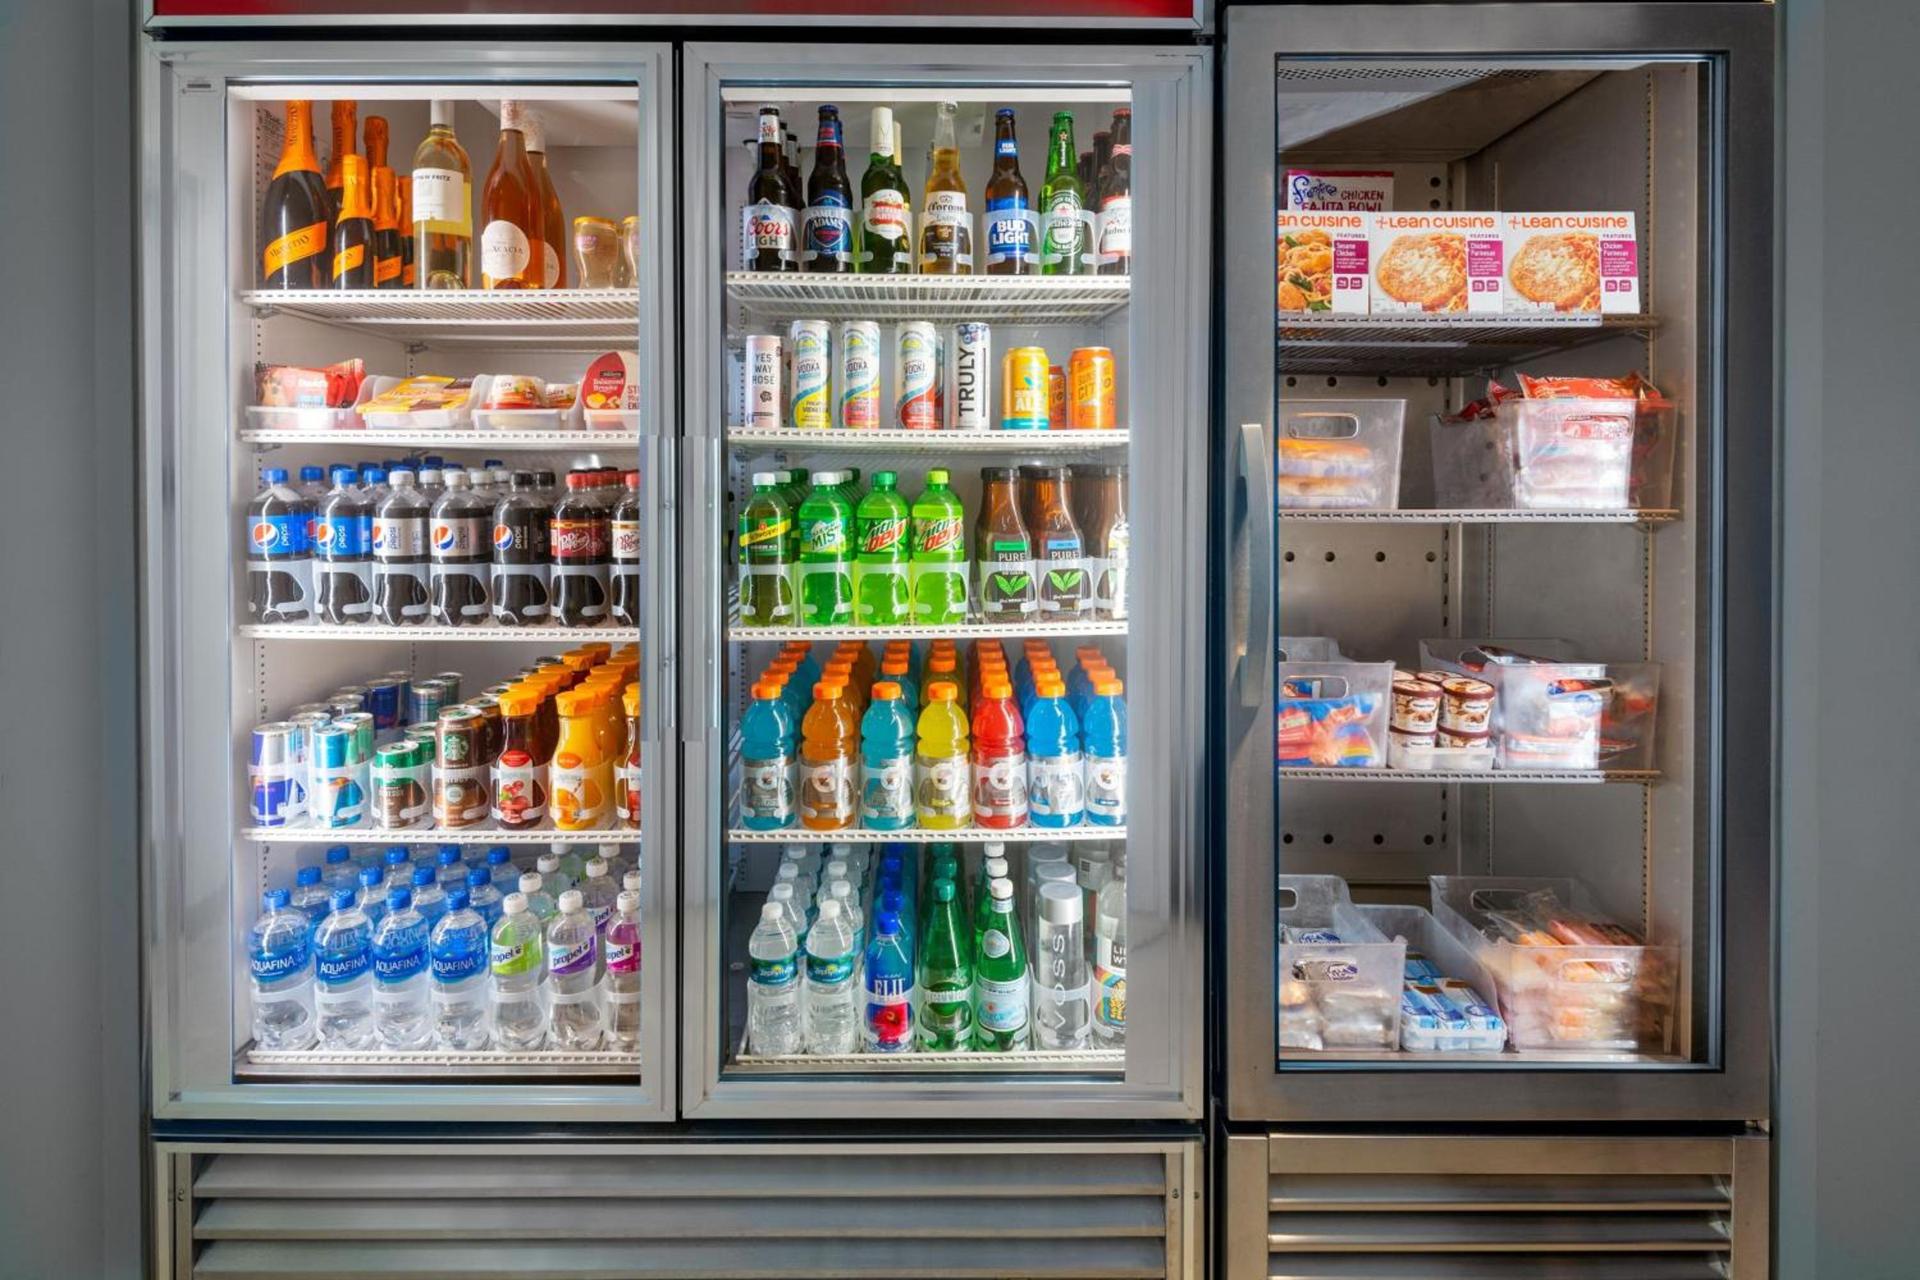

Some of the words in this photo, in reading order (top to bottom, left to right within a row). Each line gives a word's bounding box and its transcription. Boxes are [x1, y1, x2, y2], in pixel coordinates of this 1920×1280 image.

[1341, 191, 1384, 200] CHICKEN
[749, 215, 788, 236] Coors
[996, 219, 1026, 233] BUD
[992, 232, 1030, 245] LIGHT
[755, 353, 772, 362] YES
[755, 364, 773, 373] WAY
[958, 347, 975, 417] TRULY
[812, 529, 838, 550] MIS
[1000, 552, 1026, 561] PURE
[1052, 551, 1079, 560] PURE
[320, 954, 368, 975] AQUAFINA
[376, 954, 420, 975] AQUAFINA
[553, 946, 582, 967] propel
[432, 957, 475, 975] AQUAFINA
[1053, 934, 1066, 1029] VOSS
